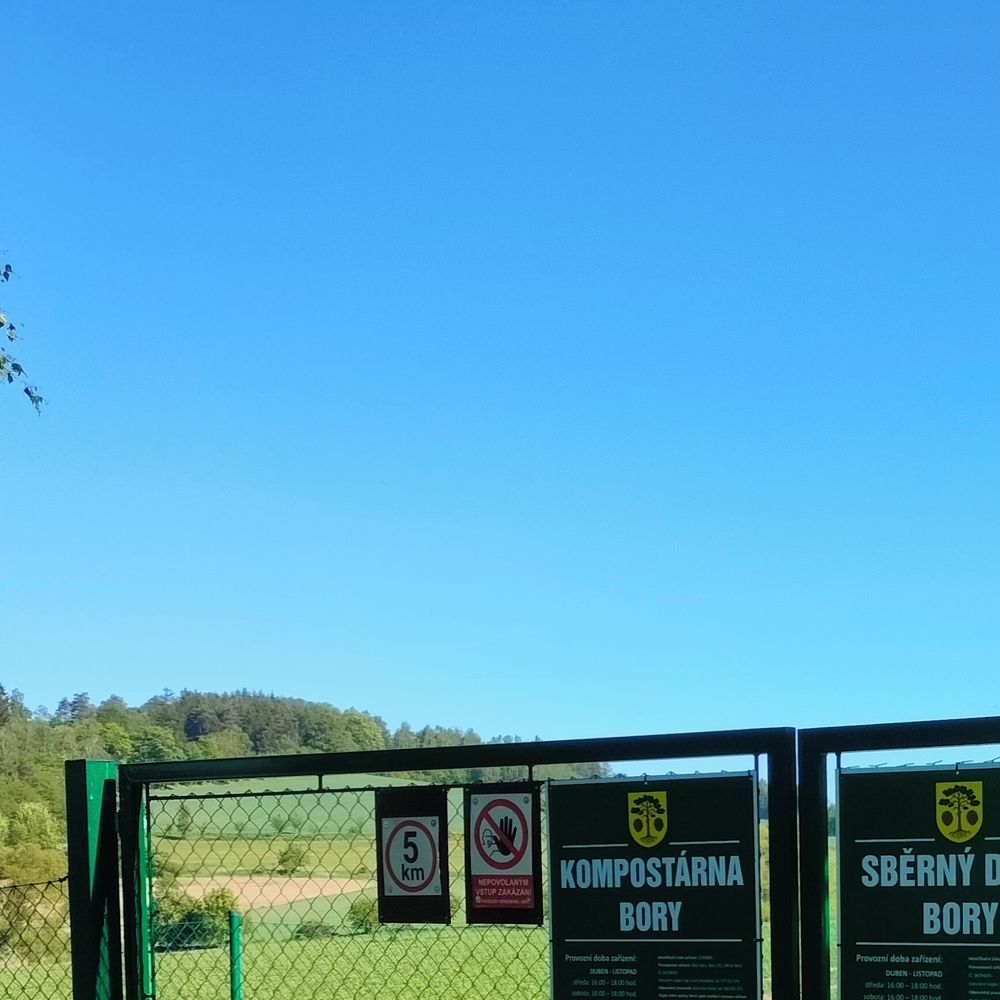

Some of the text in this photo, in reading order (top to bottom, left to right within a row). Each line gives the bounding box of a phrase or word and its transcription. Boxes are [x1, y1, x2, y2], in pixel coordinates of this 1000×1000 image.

[403, 831, 419, 863] 5
[401, 863, 425, 881] km
[560, 850, 744, 888] KOMPOSTÁRNA
[861, 846, 975, 888] SBĚRNÝ
[478, 877, 529, 886] NEPOVOLANÝM
[475, 888, 497, 896] VSTUP
[619, 901, 683, 932] BORY
[922, 901, 999, 935] BORY
[565, 953, 593, 962] Provozní
[593, 953, 610, 962] doba
[856, 953, 944, 964] Provozní doba zařízení:
[885, 969, 908, 977] DUBEN
[912, 970, 943, 978] LISTOPAD
